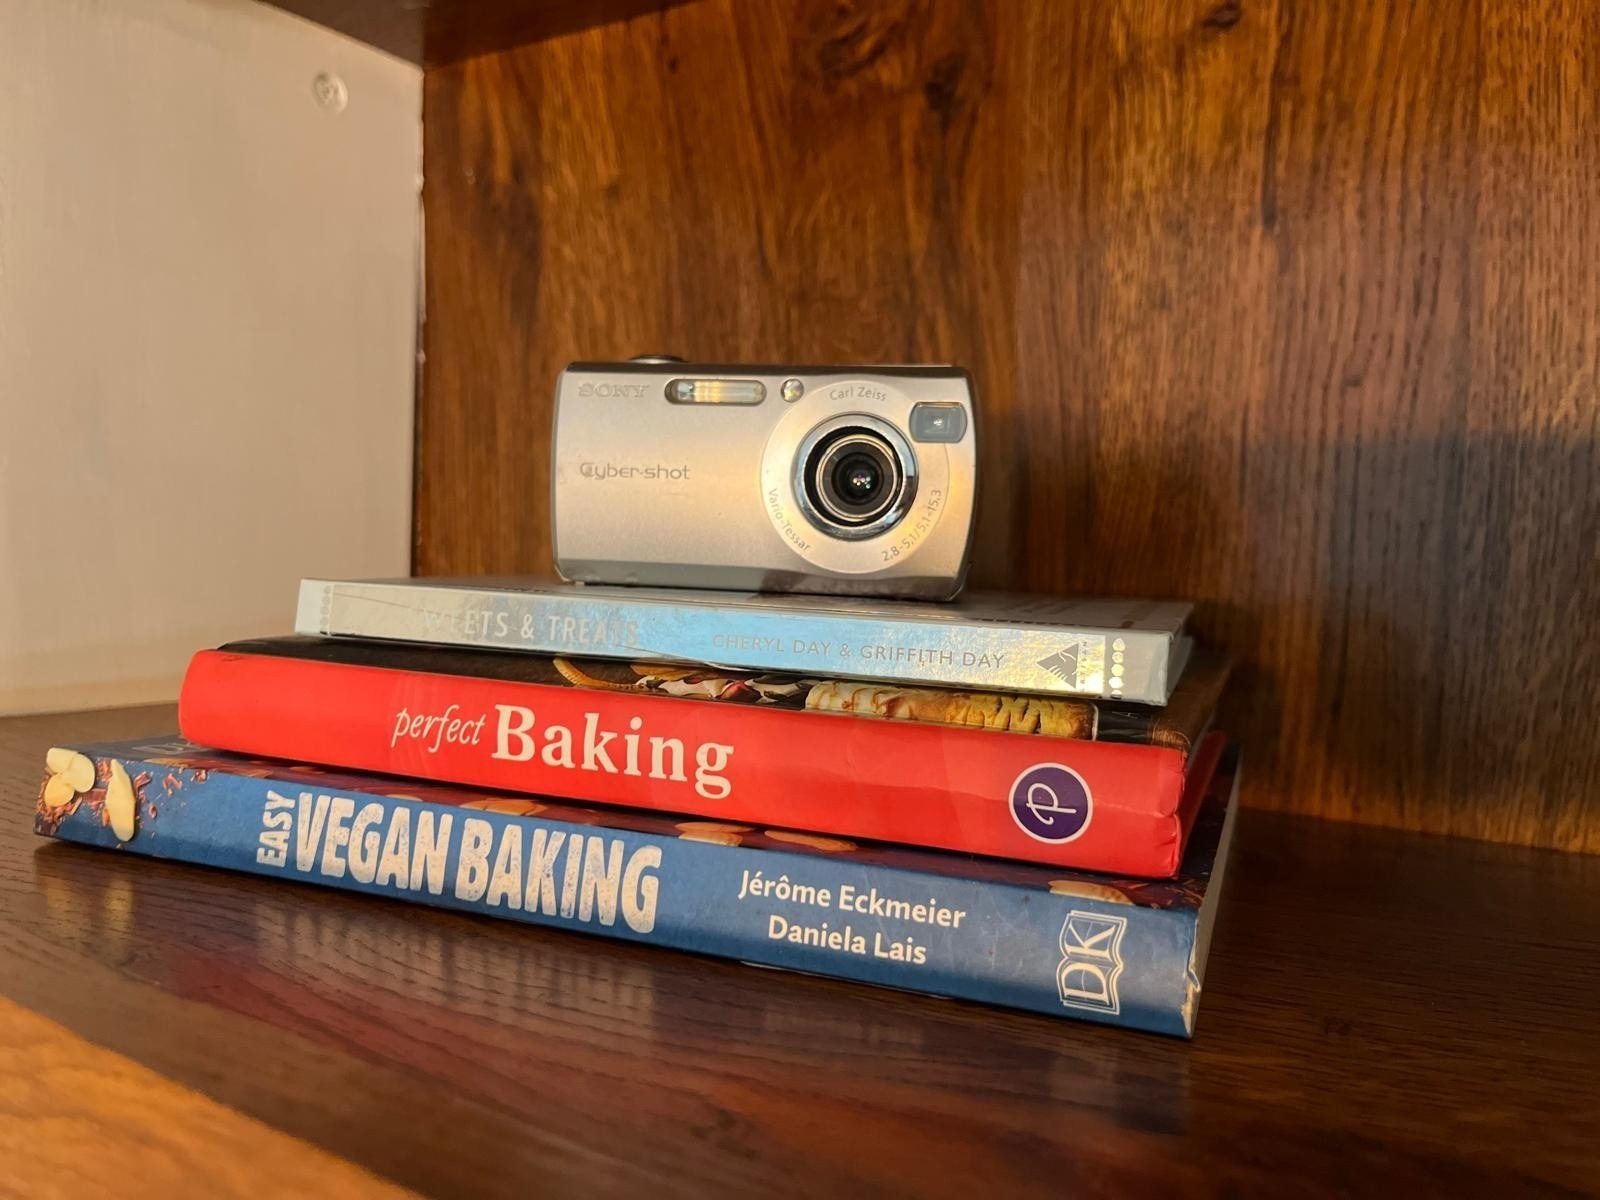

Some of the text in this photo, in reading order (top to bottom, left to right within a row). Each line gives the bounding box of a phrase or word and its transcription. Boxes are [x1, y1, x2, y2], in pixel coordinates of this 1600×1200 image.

[578, 382, 650, 398] SONY
[829, 386, 887, 402] Carl Zeiss
[580, 462, 691, 480] Cyber-shot
[767, 487, 811, 552] Vario-Tessar
[520, 613, 535, 639] &
[548, 615, 639, 647] TREATS
[711, 634, 1005, 669] CHERYL DAY & GRIFFITH DAY
[390, 703, 735, 800] perfect Baking
[256, 789, 663, 934] EASY VEGAN BAKING
[737, 869, 967, 929] Jérôme Eckmeier
[767, 914, 928, 966] Daniela Lais
[1060, 920, 1118, 1007] DK
